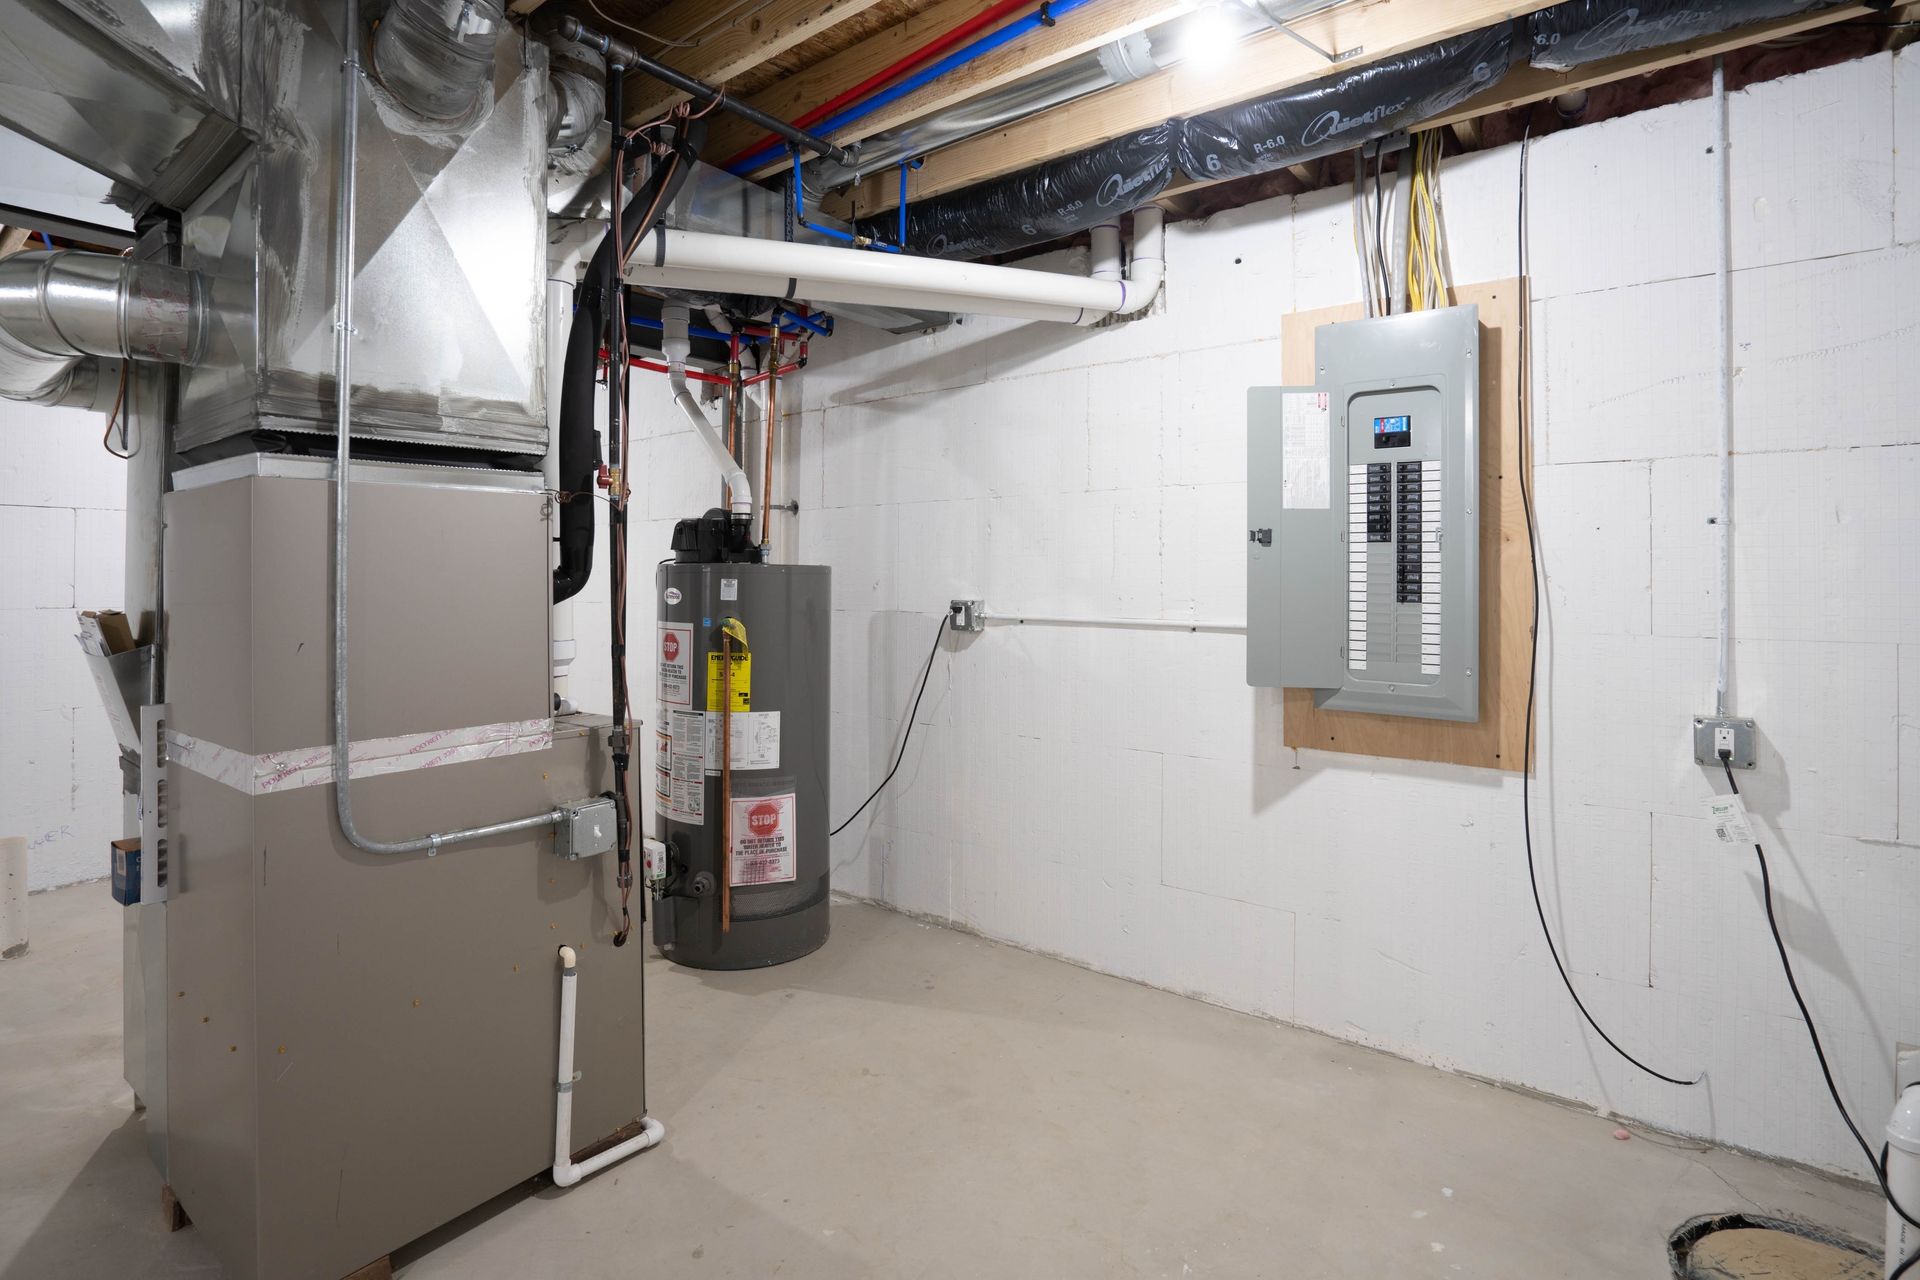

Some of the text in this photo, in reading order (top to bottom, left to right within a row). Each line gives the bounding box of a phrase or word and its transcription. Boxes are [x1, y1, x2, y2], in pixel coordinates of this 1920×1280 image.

[1472, 62, 1491, 82] 6
[1301, 101, 1406, 147] Quietflex
[1253, 135, 1286, 154] R-6.0
[1206, 153, 1222, 171] 6
[1056, 200, 1084, 217] R-6.0
[1021, 224, 1037, 236] 6
[664, 641, 678, 652] STOP
[751, 813, 777, 826] STOP
